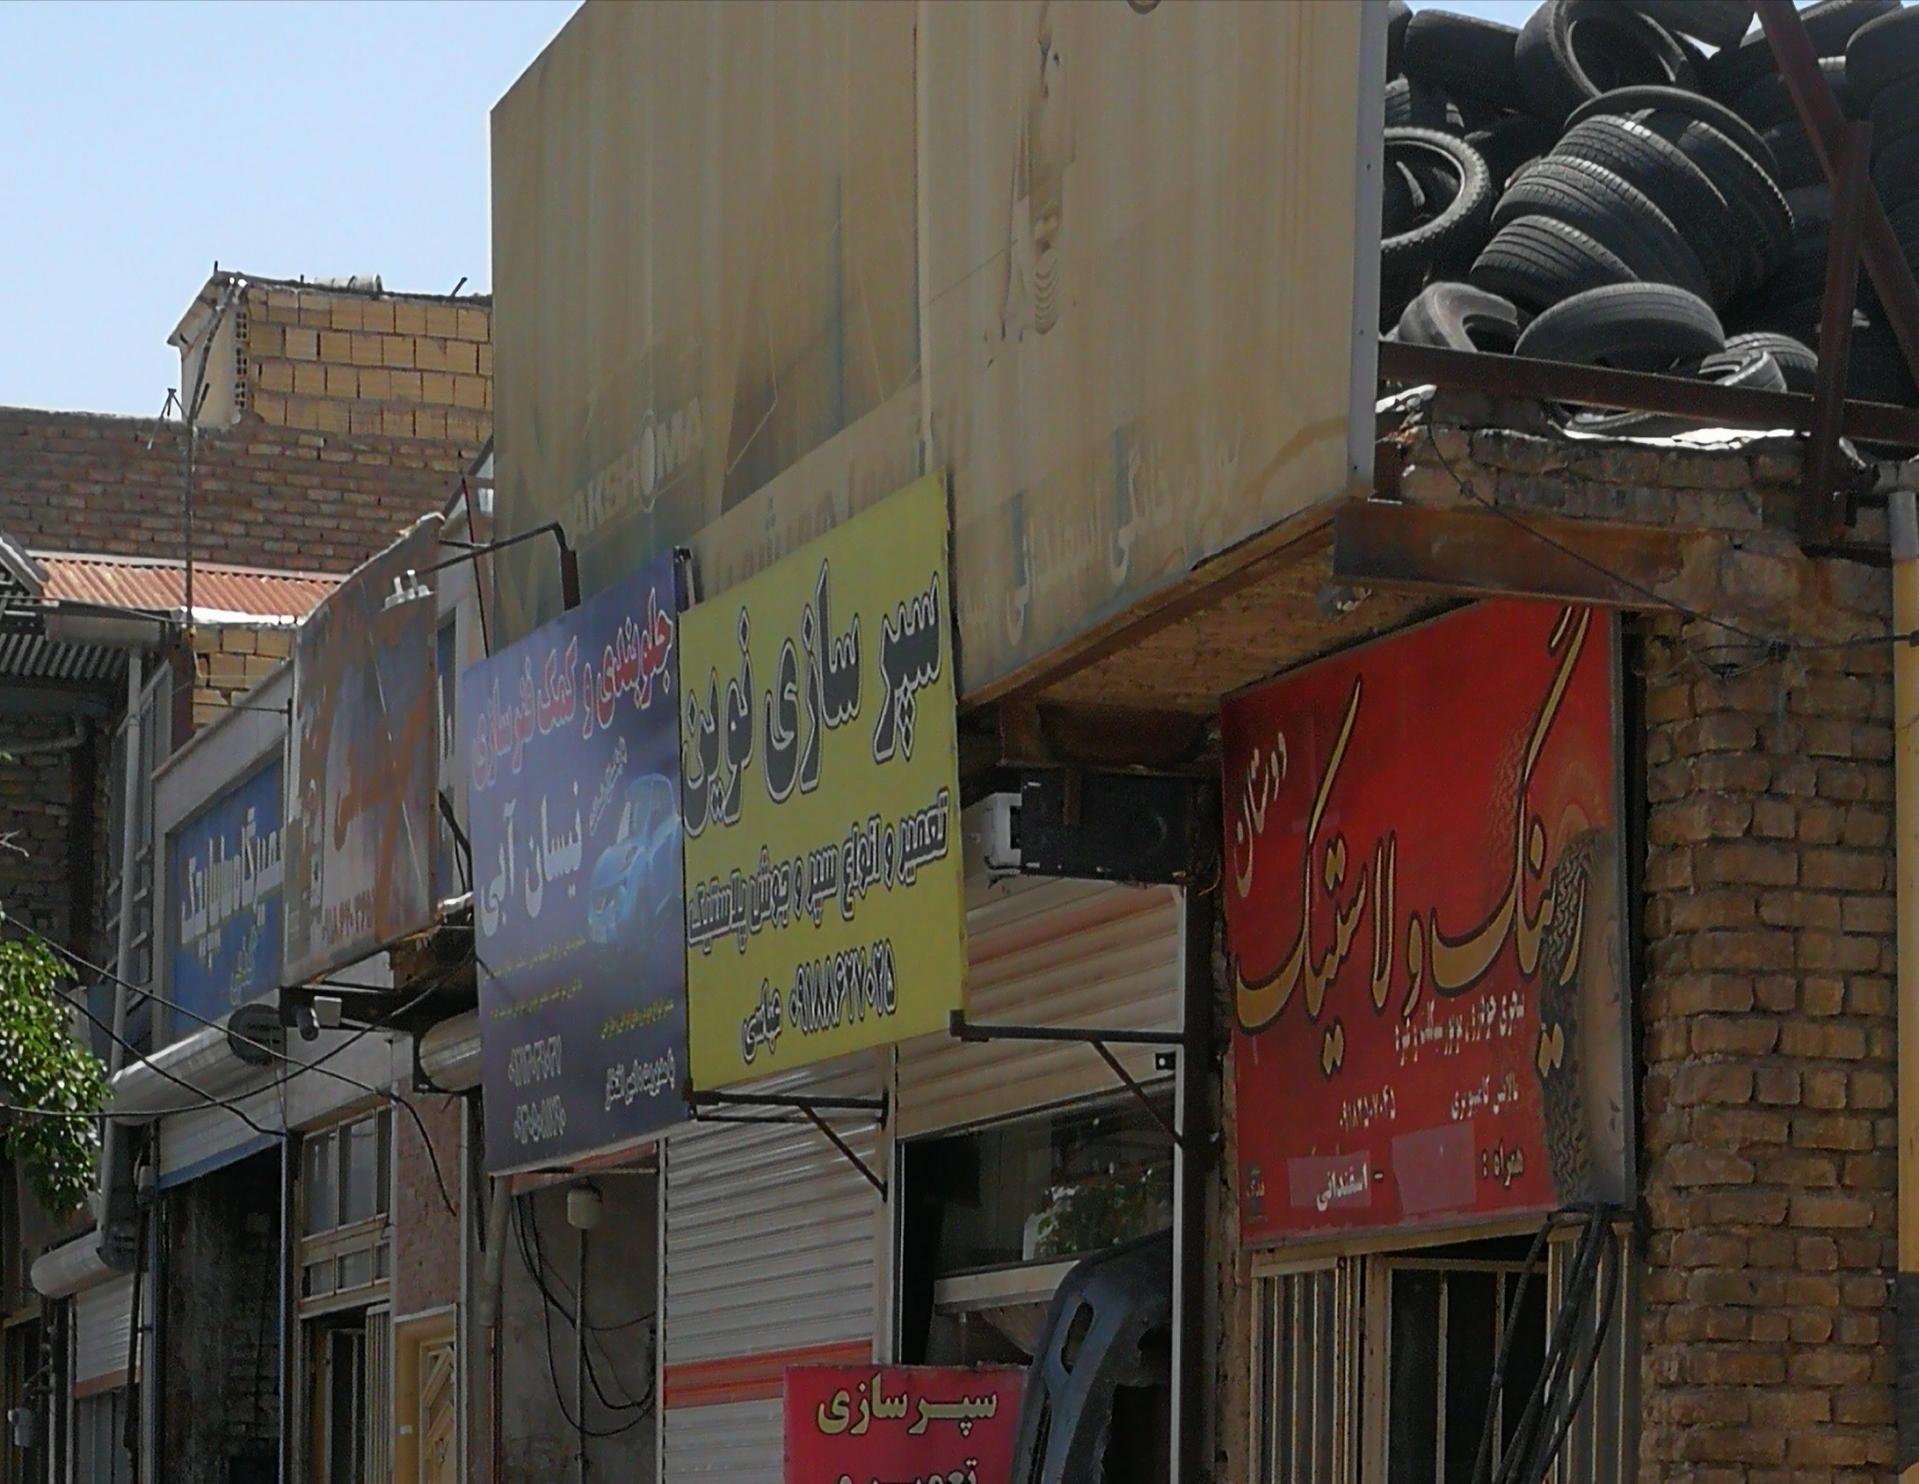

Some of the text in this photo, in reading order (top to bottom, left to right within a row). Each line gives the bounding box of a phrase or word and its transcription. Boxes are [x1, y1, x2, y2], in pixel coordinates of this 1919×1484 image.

[537, 635, 578, 736] کمک
[582, 662, 594, 740] و
[596, 587, 674, 729] جلوبندی
[682, 605, 755, 838] نوین
[764, 557, 861, 804] سازی
[873, 570, 943, 763] سپر
[479, 798, 518, 937] آبی
[525, 779, 583, 920] نیسان
[688, 787, 949, 955] تعمیر و انواع سپر و جوش پلاستیک
[1234, 730, 1288, 899] دوستان
[1235, 604, 1593, 1078] رینگ و لاستیک
[816, 1372, 998, 1436] سپر سازی
